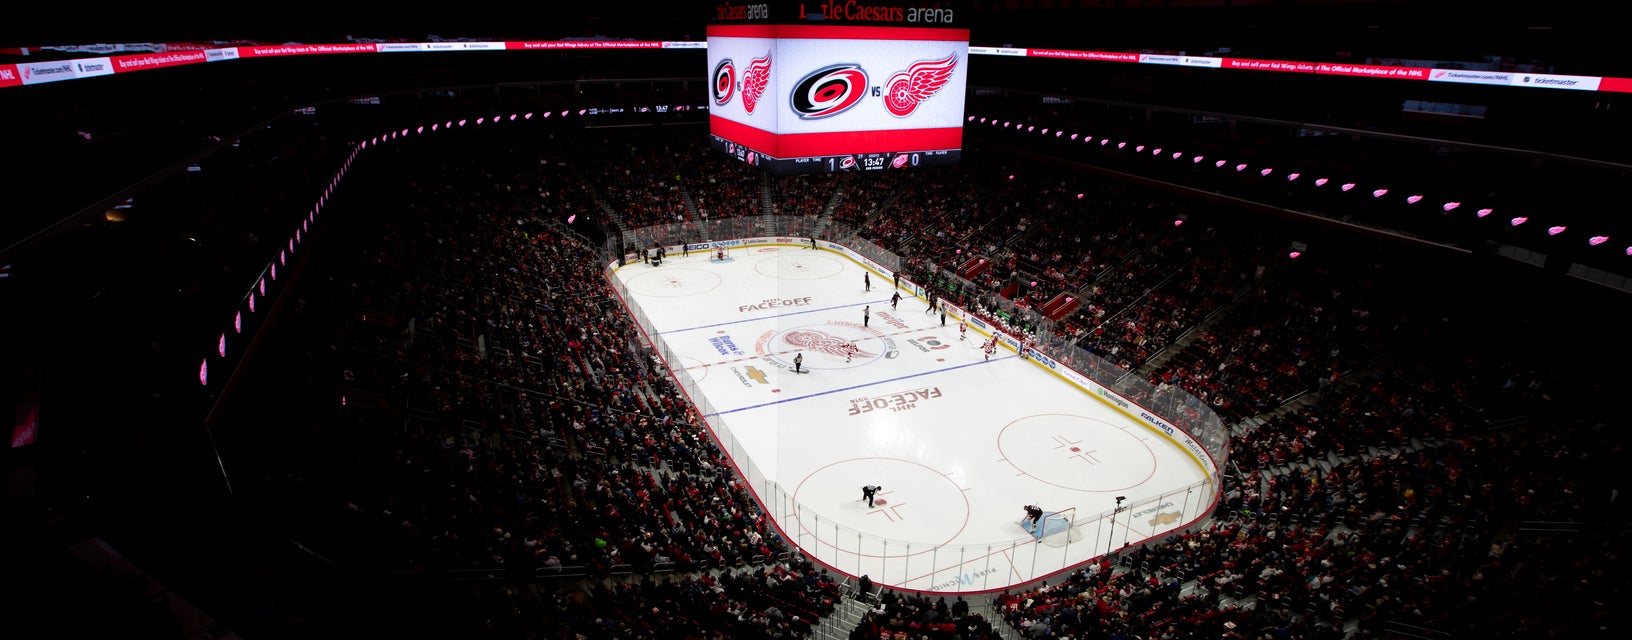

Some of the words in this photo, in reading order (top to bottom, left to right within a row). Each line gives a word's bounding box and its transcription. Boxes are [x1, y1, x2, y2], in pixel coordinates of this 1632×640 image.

[747, 3, 768, 20] arena
[845, 0, 904, 21] Caesars
[907, 7, 953, 23] arena
[871, 86, 881, 97] VS
[828, 158, 835, 171] 1
[864, 157, 884, 167] 13:47
[738, 296, 812, 313] FACE-OFF
[848, 387, 943, 416] FACE-OFF
[889, 403, 916, 413] NHL
[1103, 390, 1129, 409] Huntington
[1140, 412, 1174, 434] FALKEN
